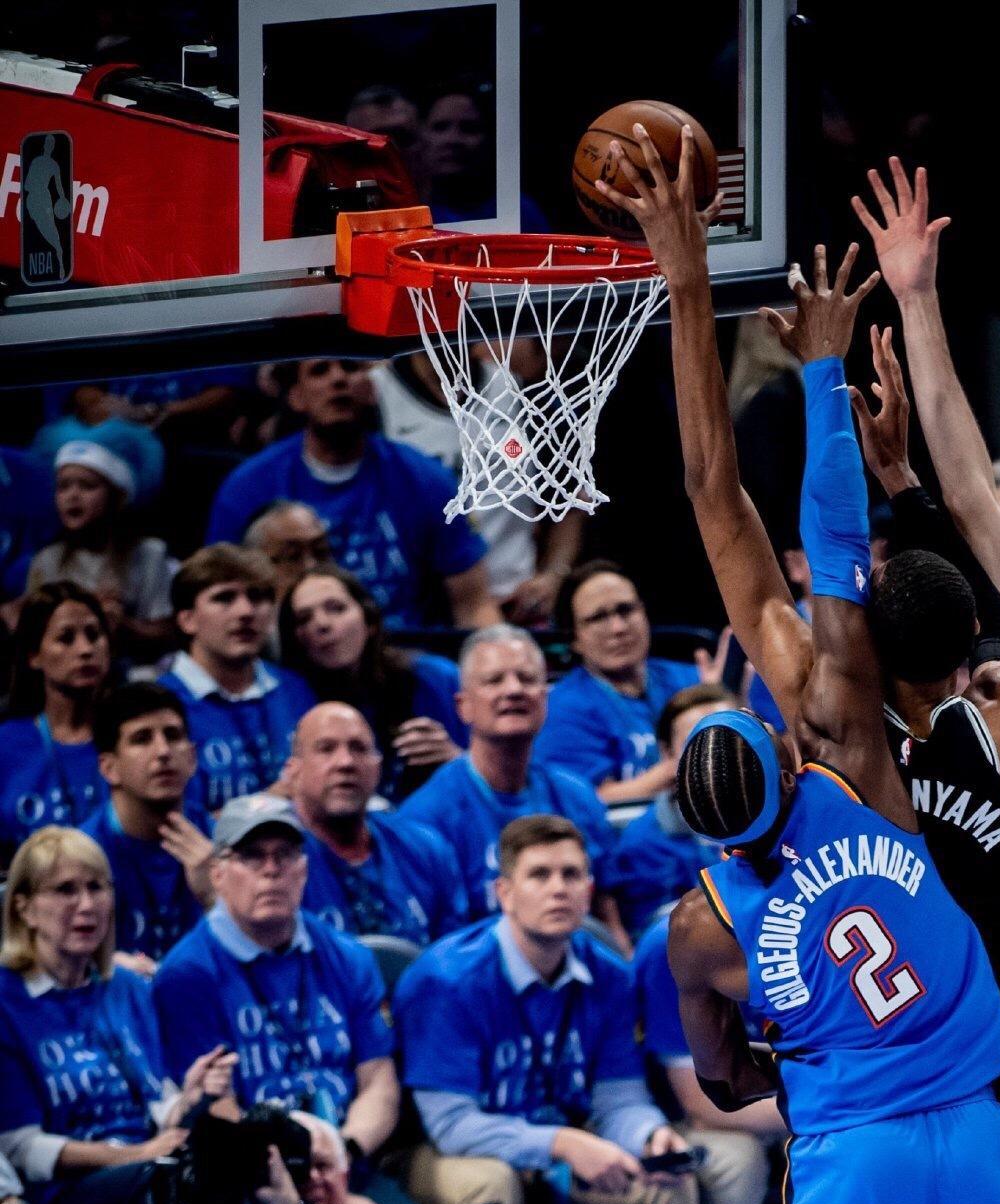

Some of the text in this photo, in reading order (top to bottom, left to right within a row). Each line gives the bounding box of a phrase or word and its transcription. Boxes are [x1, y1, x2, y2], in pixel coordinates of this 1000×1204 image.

[0, 153, 109, 237] Fm
[29, 251, 53, 276] NBA
[757, 834, 926, 1011] GILGEOUS-ALEXANDER
[823, 905, 928, 1029] 2
